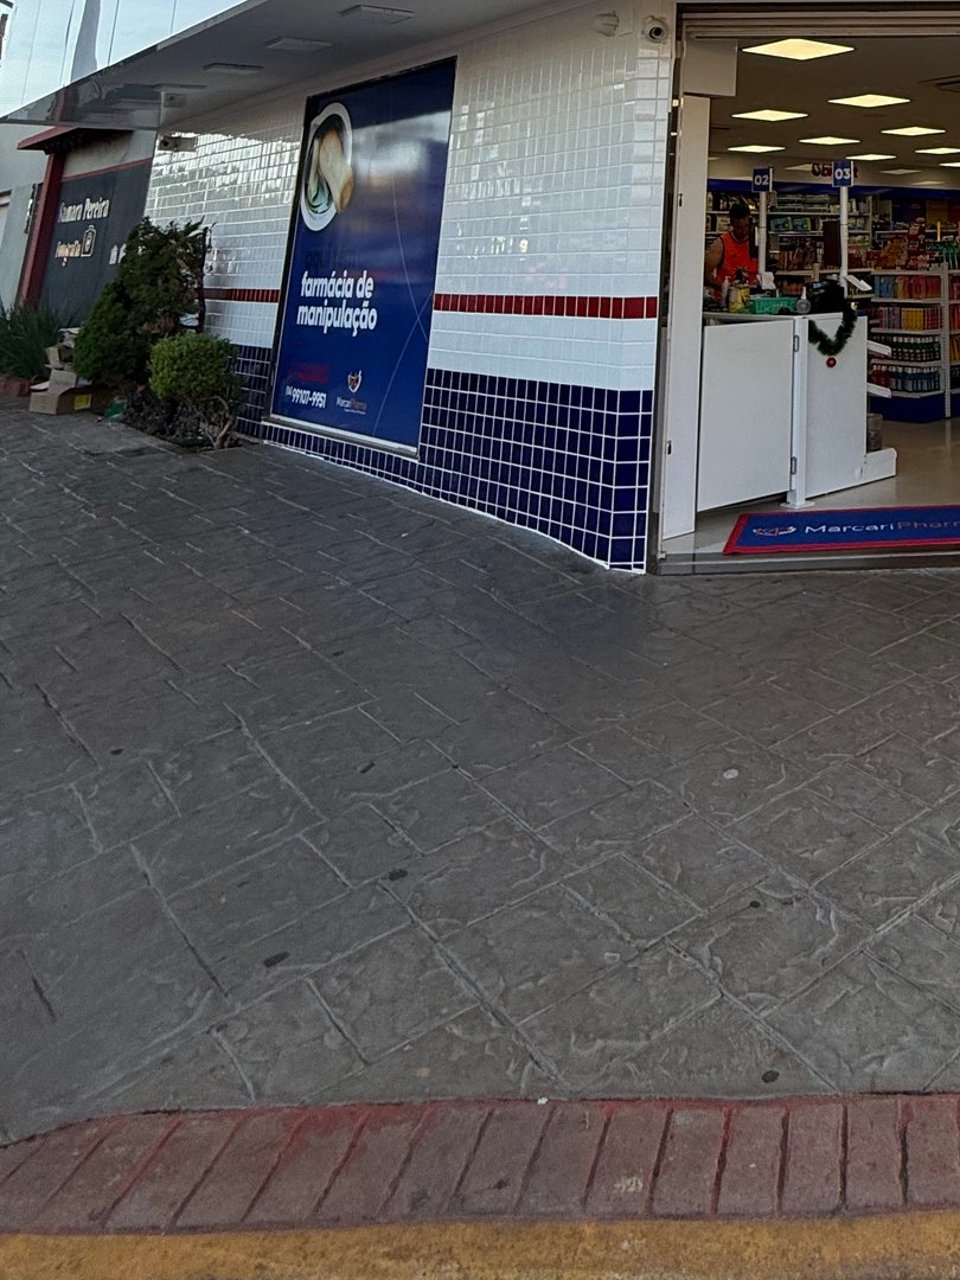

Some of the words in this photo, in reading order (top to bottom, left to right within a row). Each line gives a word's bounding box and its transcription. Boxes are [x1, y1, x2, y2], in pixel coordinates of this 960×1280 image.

[754, 175, 769, 186] 02
[835, 168, 851, 180] 03
[301, 269, 355, 298] farmácia
[355, 269, 374, 298] de
[296, 299, 378, 338] manipulação
